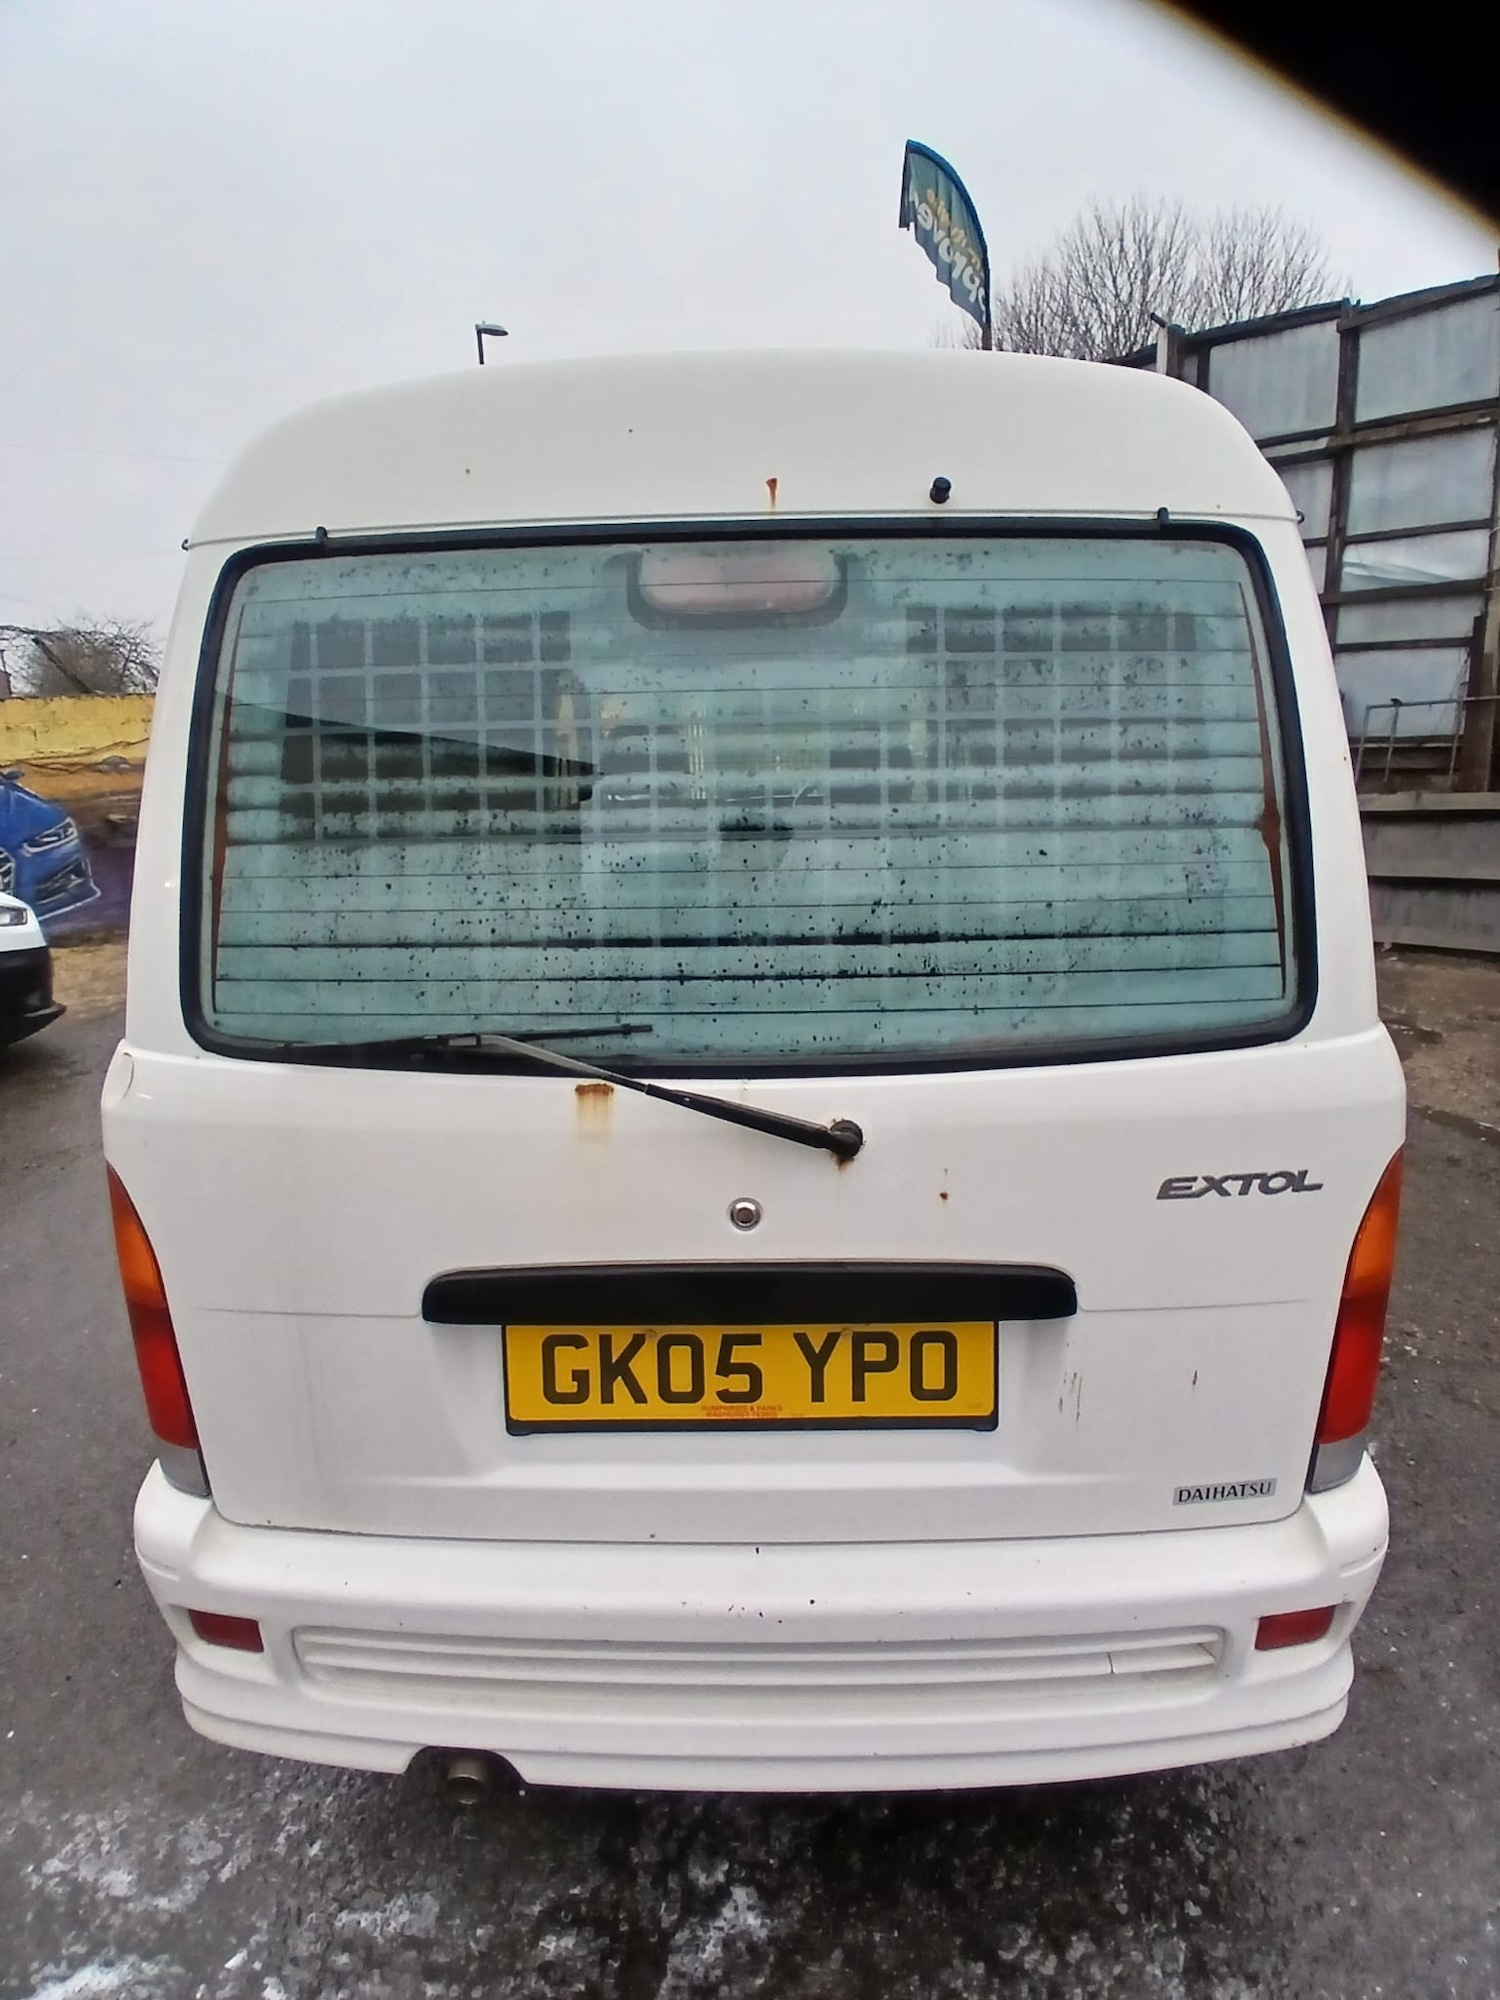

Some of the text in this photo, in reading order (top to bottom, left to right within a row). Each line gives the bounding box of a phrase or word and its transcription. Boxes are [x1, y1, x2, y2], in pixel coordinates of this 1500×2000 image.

[1156, 1170, 1324, 1200] EXTOL
[541, 1329, 958, 1405] GK05 YPO
[1178, 1481, 1272, 1503] DAIHATSU
